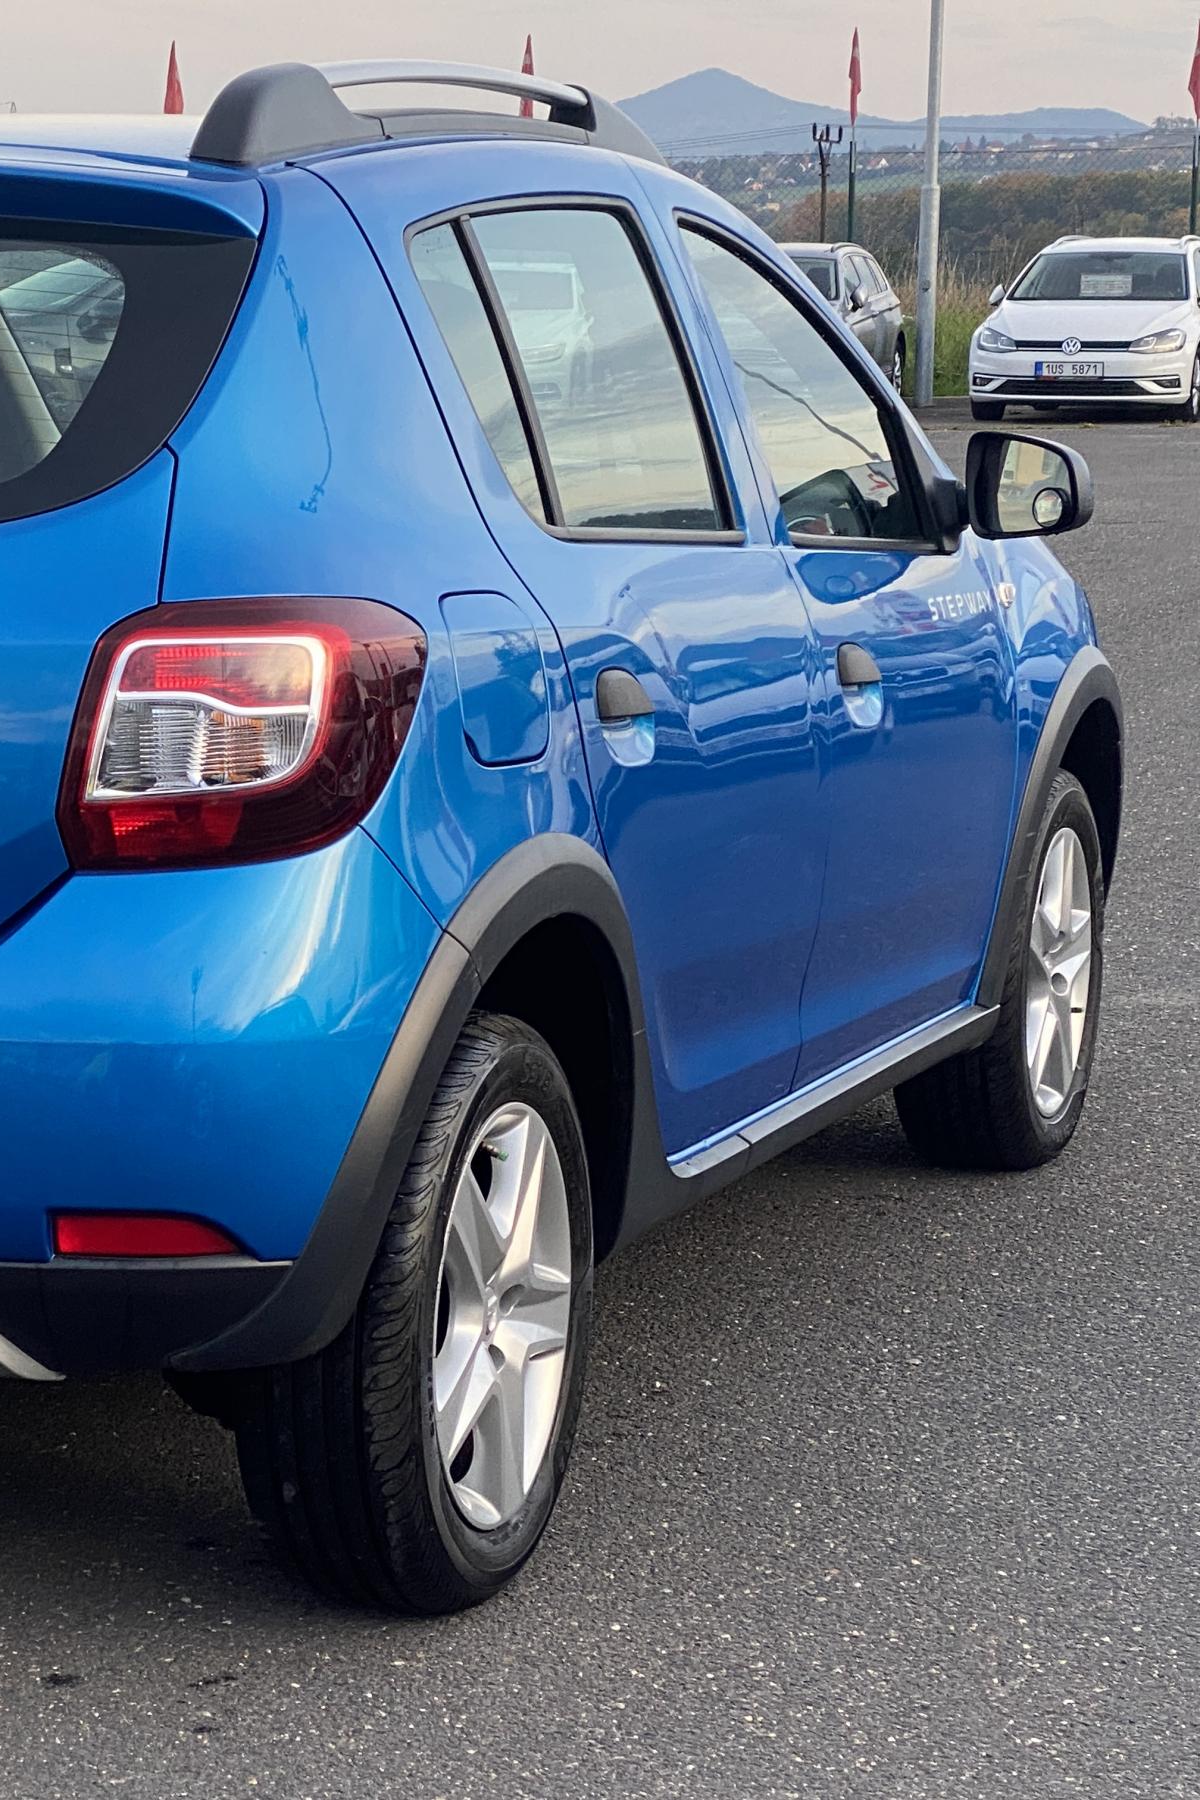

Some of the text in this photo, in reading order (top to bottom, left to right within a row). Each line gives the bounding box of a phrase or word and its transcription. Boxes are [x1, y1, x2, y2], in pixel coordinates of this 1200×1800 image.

[1045, 364, 1098, 375] 1US 5871
[927, 589, 994, 621] STEPWAY
